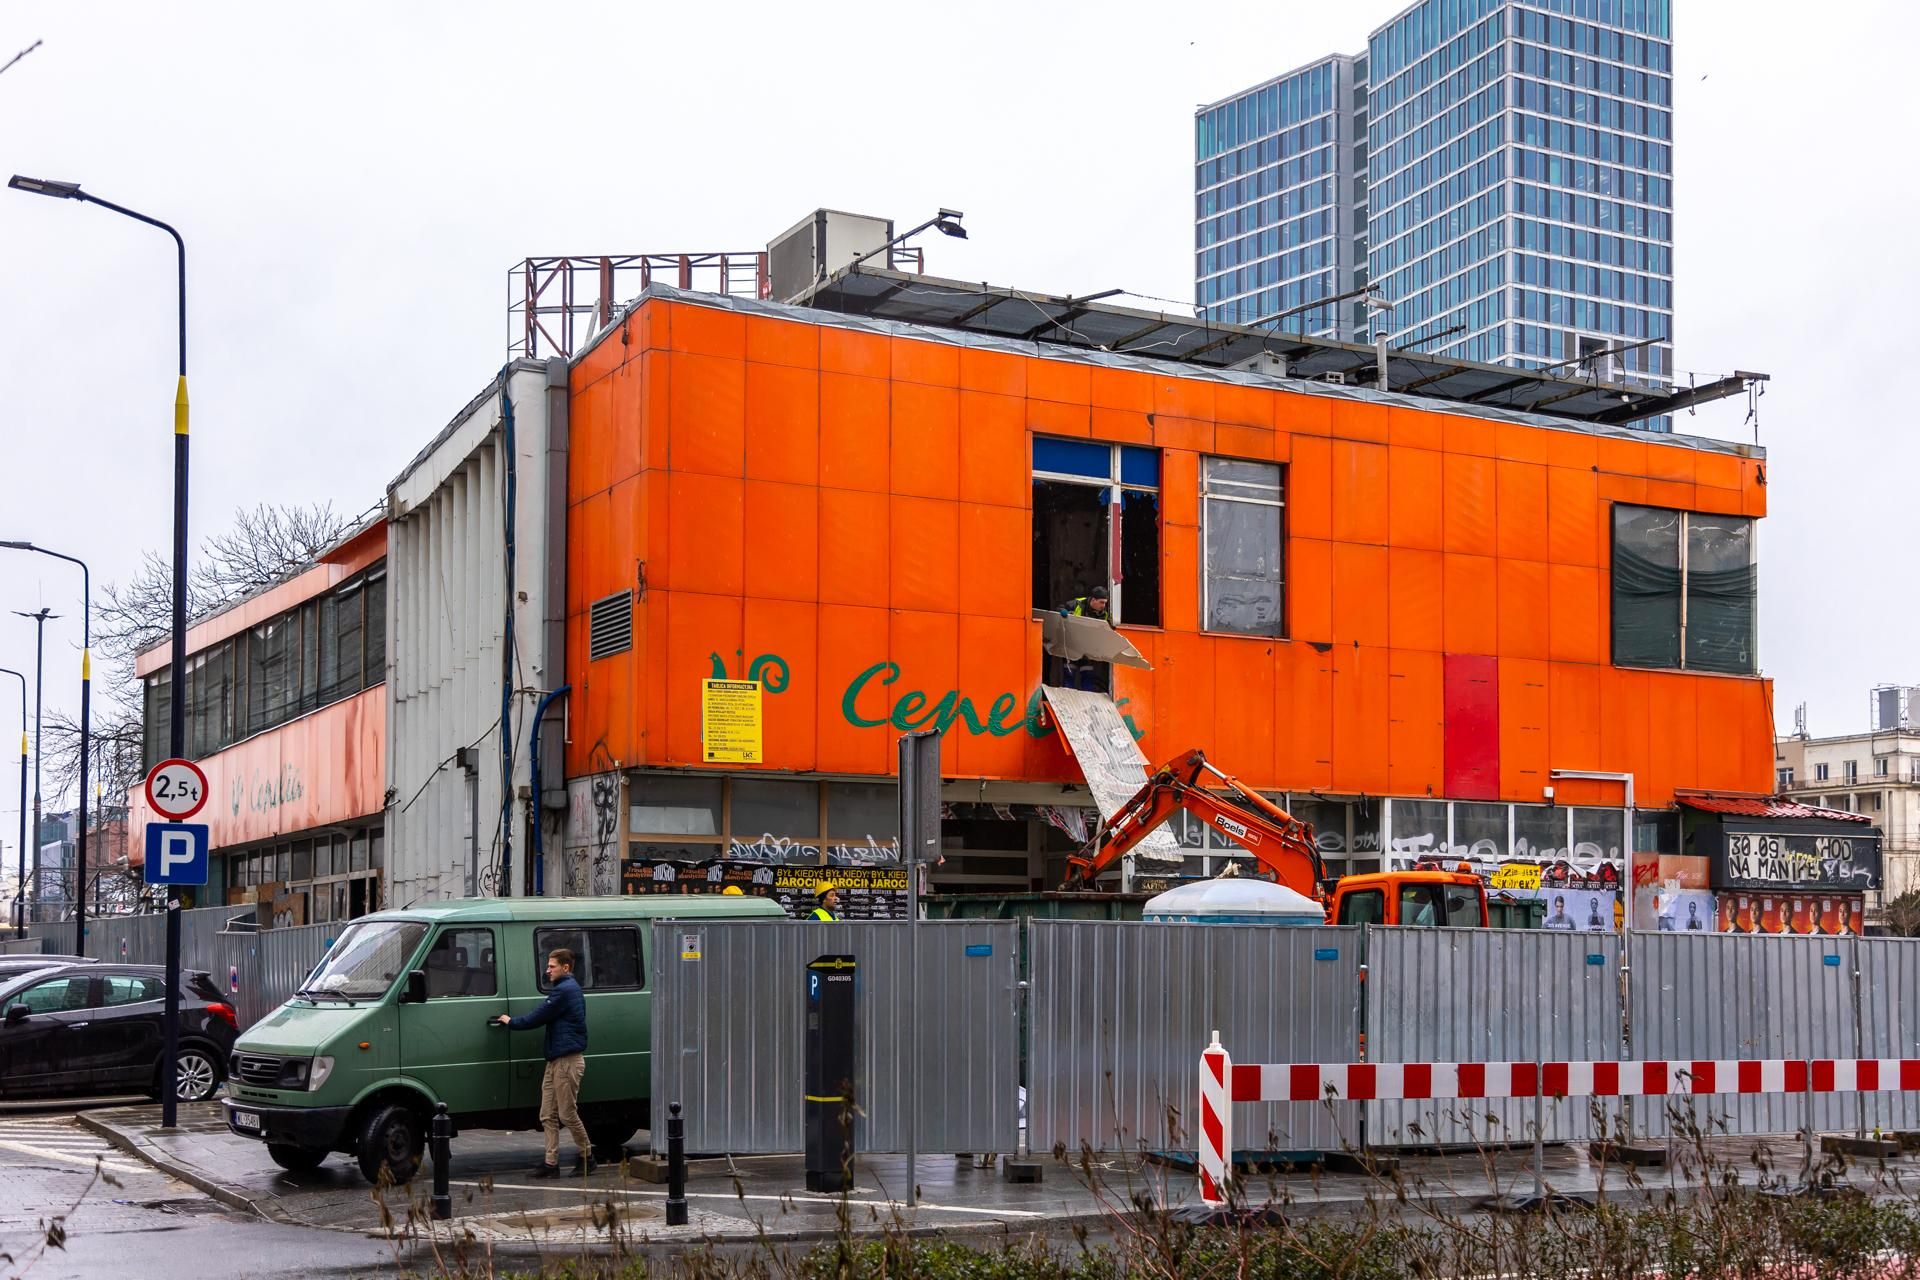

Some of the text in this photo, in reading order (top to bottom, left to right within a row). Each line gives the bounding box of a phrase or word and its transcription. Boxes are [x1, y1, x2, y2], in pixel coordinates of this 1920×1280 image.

[160, 830, 195, 877] P
[1730, 855, 1751, 877] NA
[811, 975, 818, 995] P
